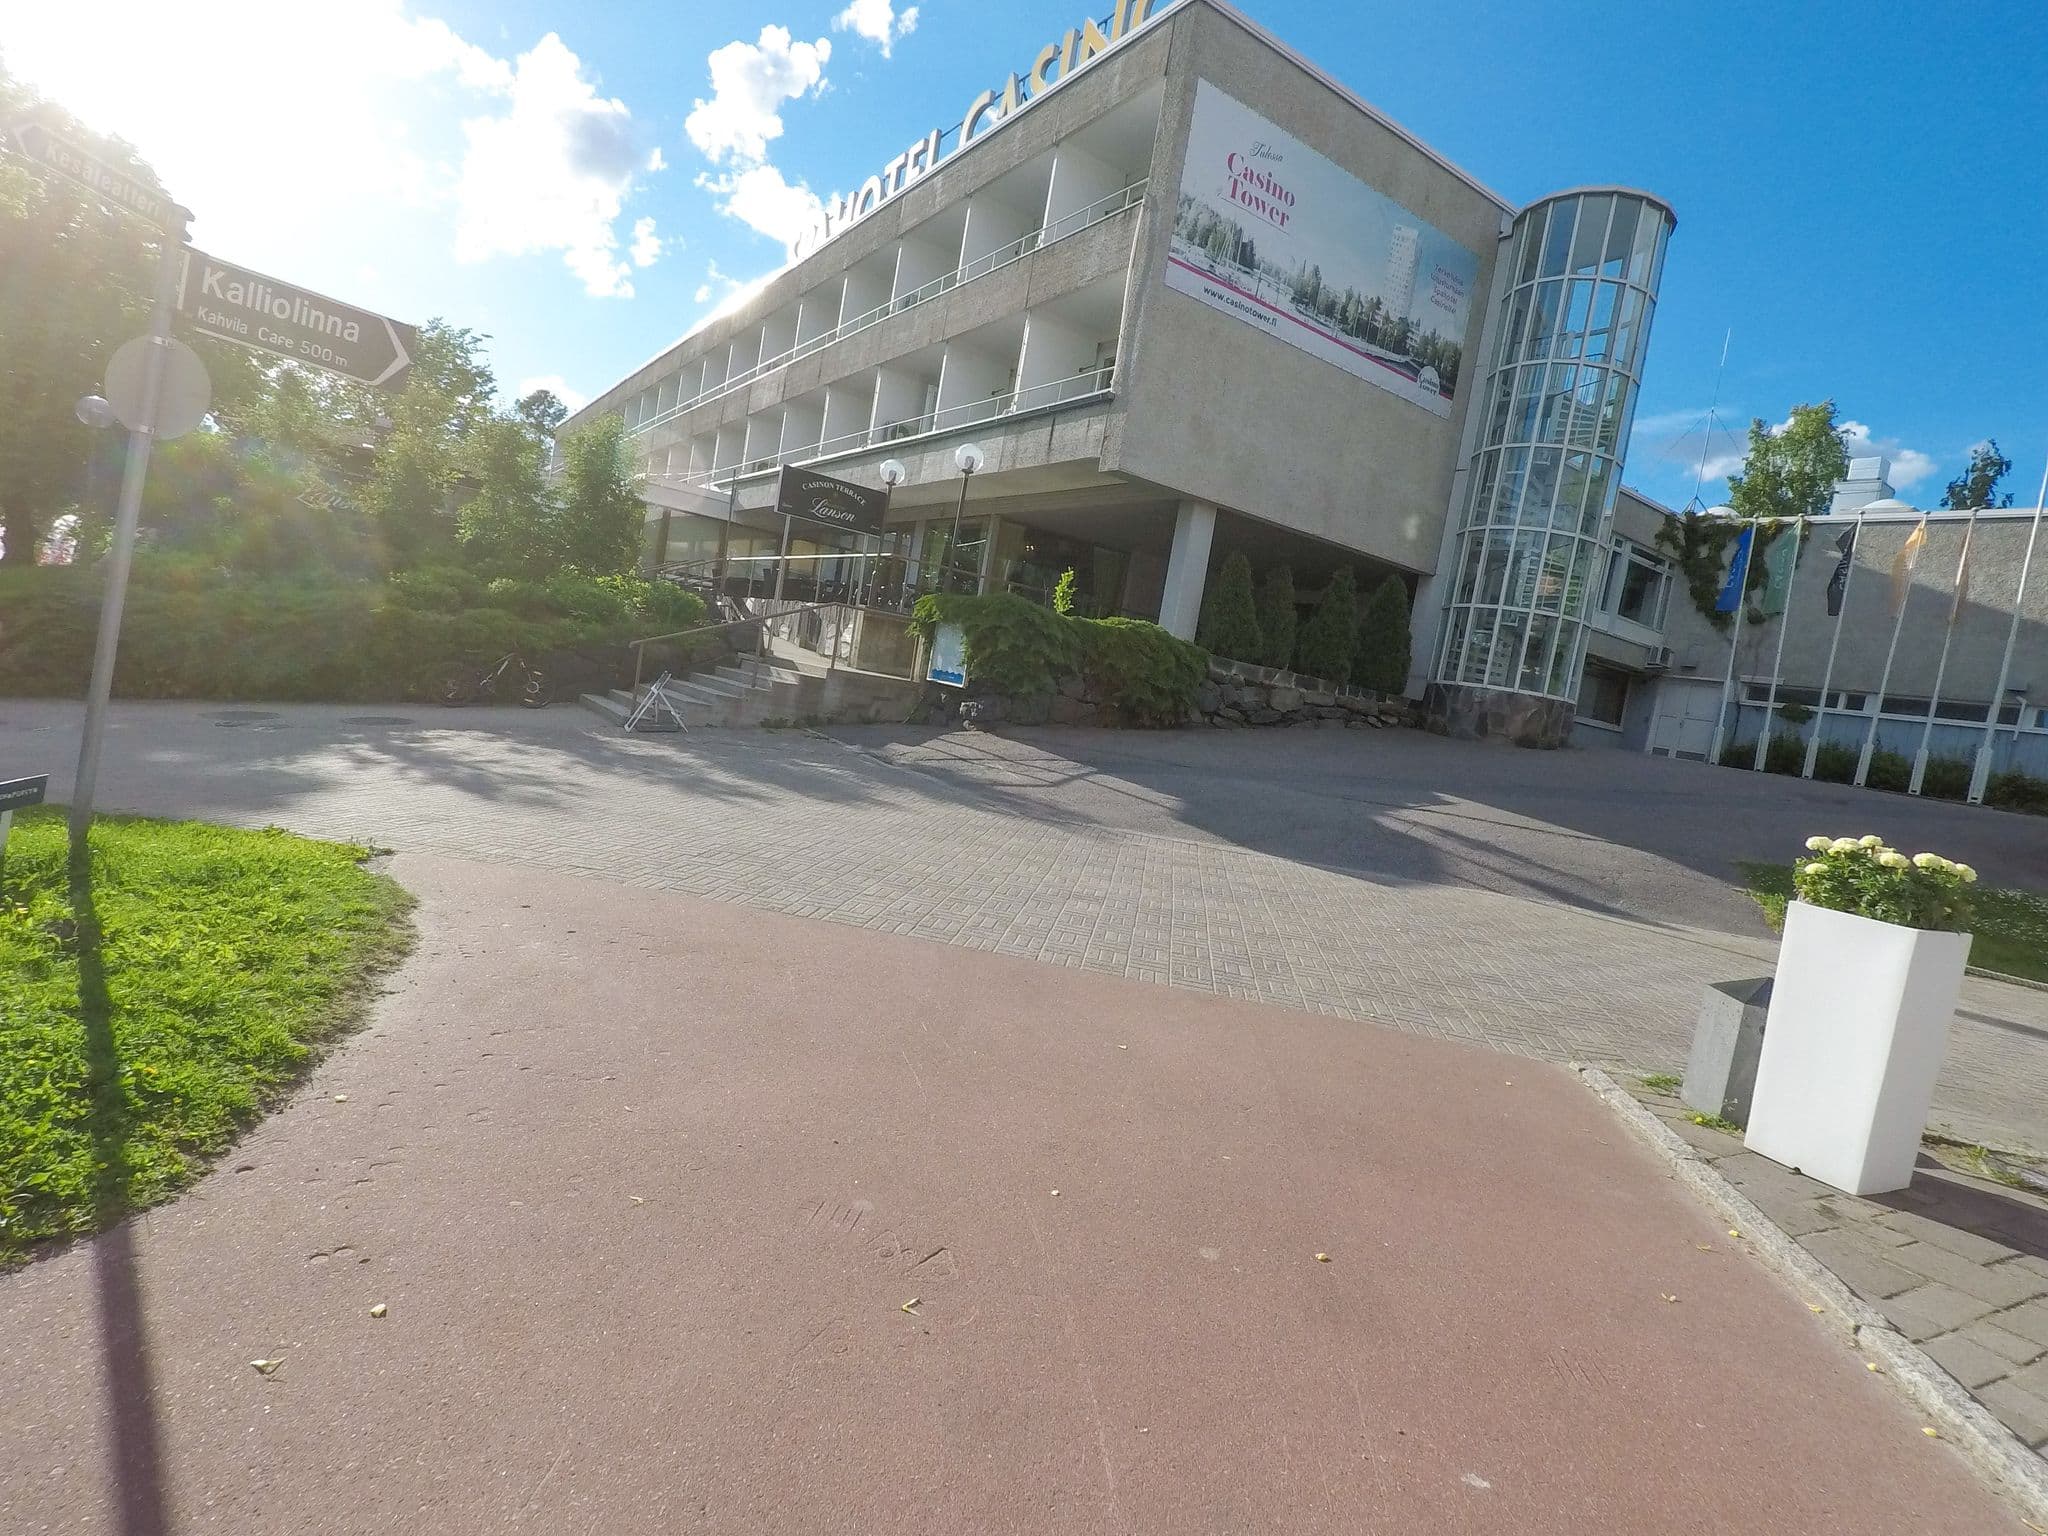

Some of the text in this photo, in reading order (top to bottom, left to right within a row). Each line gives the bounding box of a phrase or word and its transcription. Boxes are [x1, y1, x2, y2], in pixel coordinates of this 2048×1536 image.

[957, 0, 1155, 150] CASIN
[1227, 152, 1297, 207] Casino
[1228, 175, 1290, 227] Tower
[202, 266, 360, 343] Kalliolinna
[1203, 286, 1278, 327] www.casinotower.fi
[198, 306, 248, 335] Kahvila
[300, 340, 332, 362] 500
[335, 354, 348, 367] m
[802, 481, 867, 507] CASINON TERRACE
[810, 497, 858, 523] Lanson
